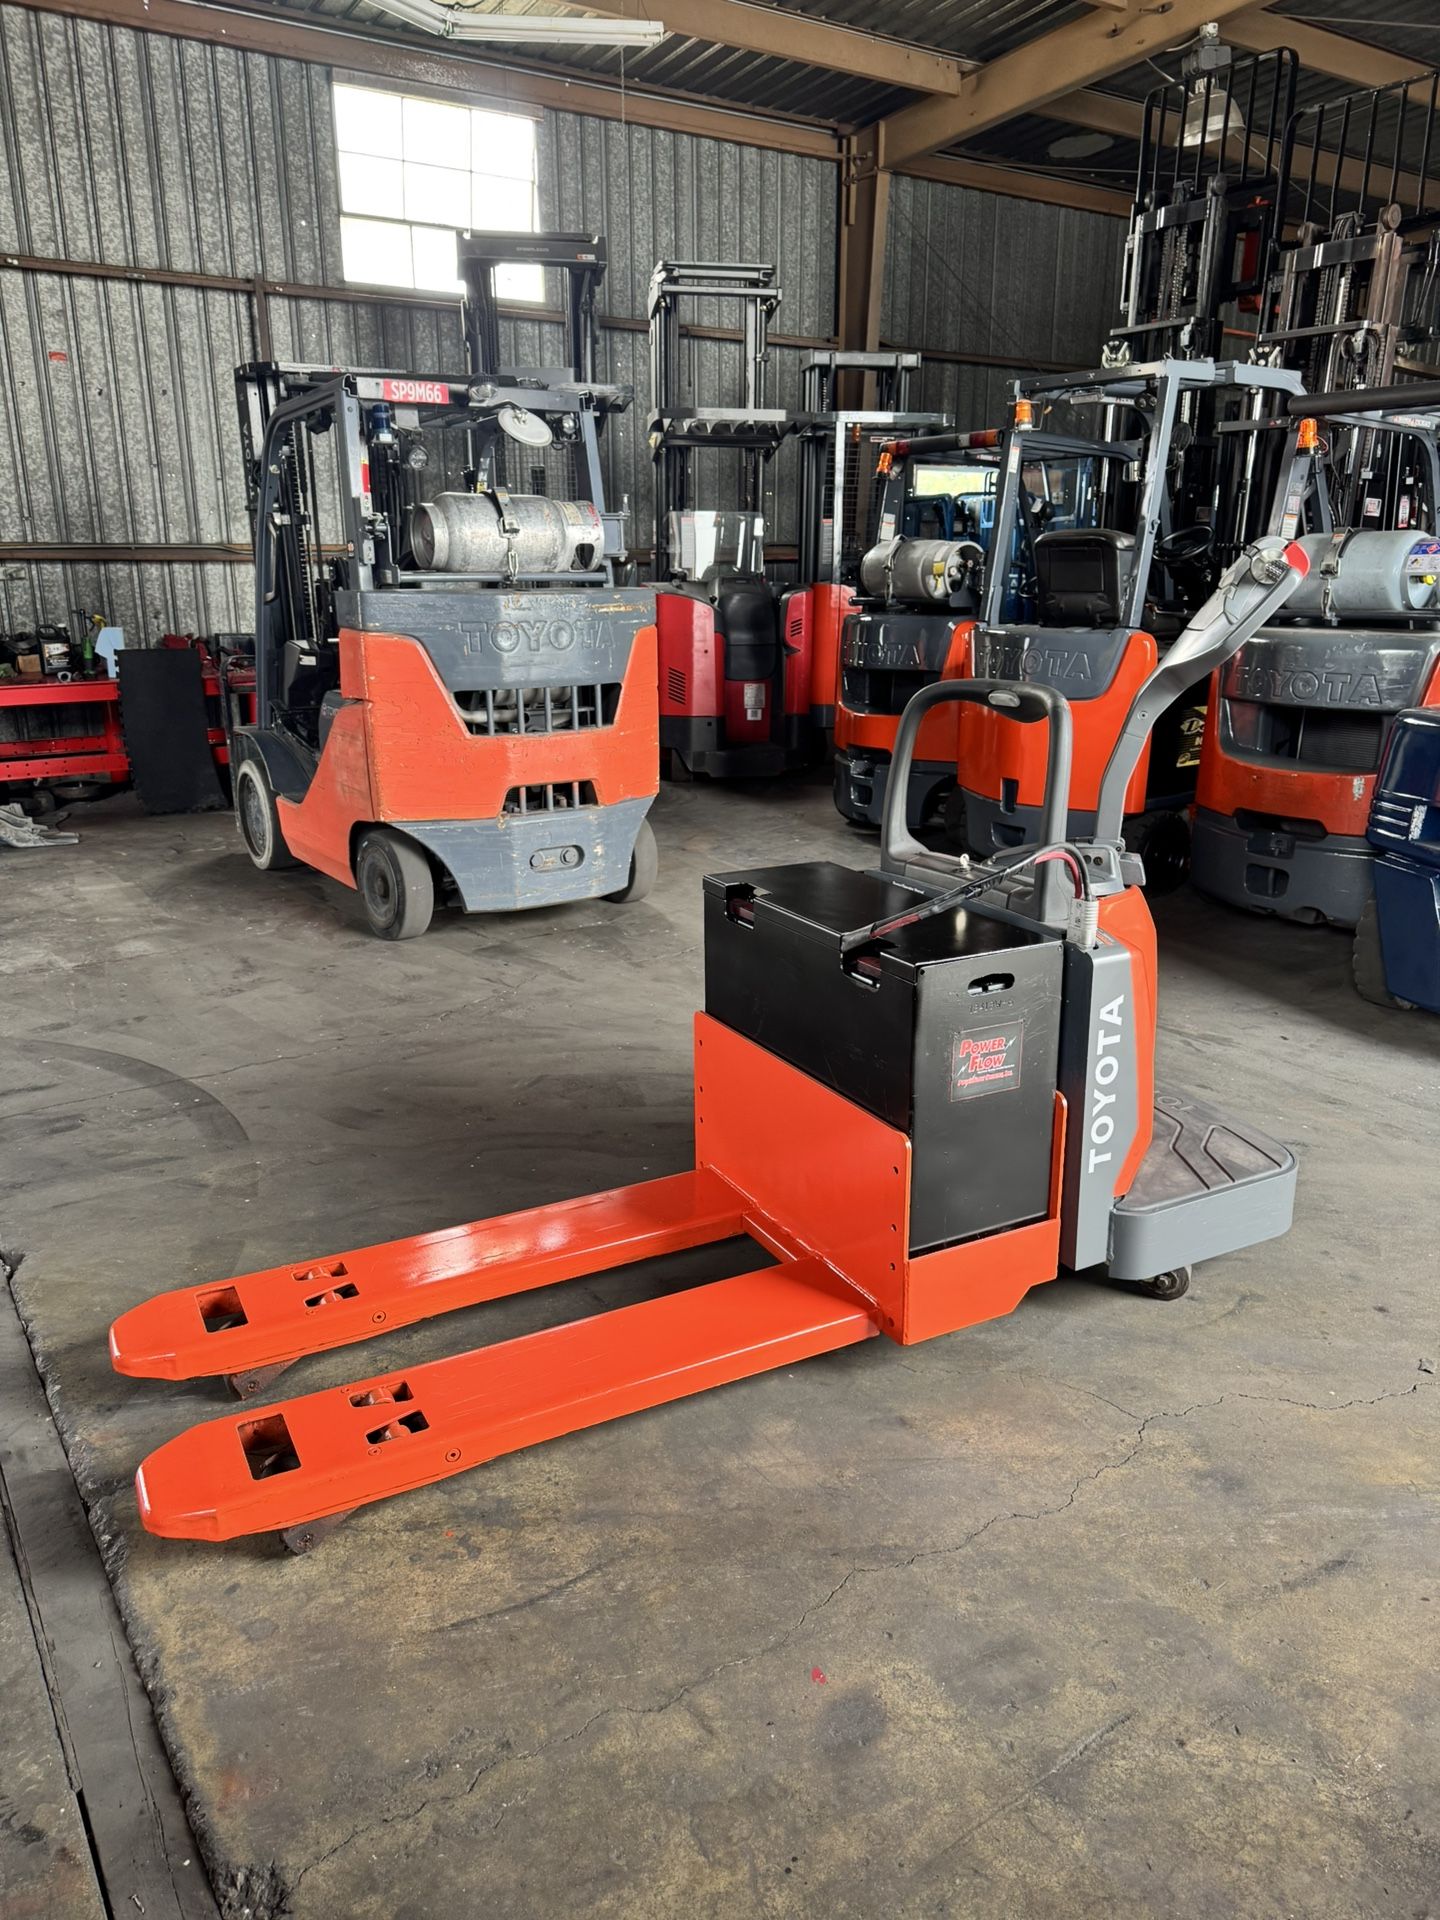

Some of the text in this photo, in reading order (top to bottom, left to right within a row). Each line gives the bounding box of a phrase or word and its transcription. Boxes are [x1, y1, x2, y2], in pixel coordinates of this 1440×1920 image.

[391, 381, 443, 403] SP9M66
[458, 618, 616, 654] TOYOTA
[843, 640, 921, 667] OTA
[1236, 665, 1384, 705] TOYOTA
[959, 1037, 1006, 1058] POWER
[968, 1053, 1007, 1073] FLOW
[1088, 994, 1125, 1174] TOYOTA
